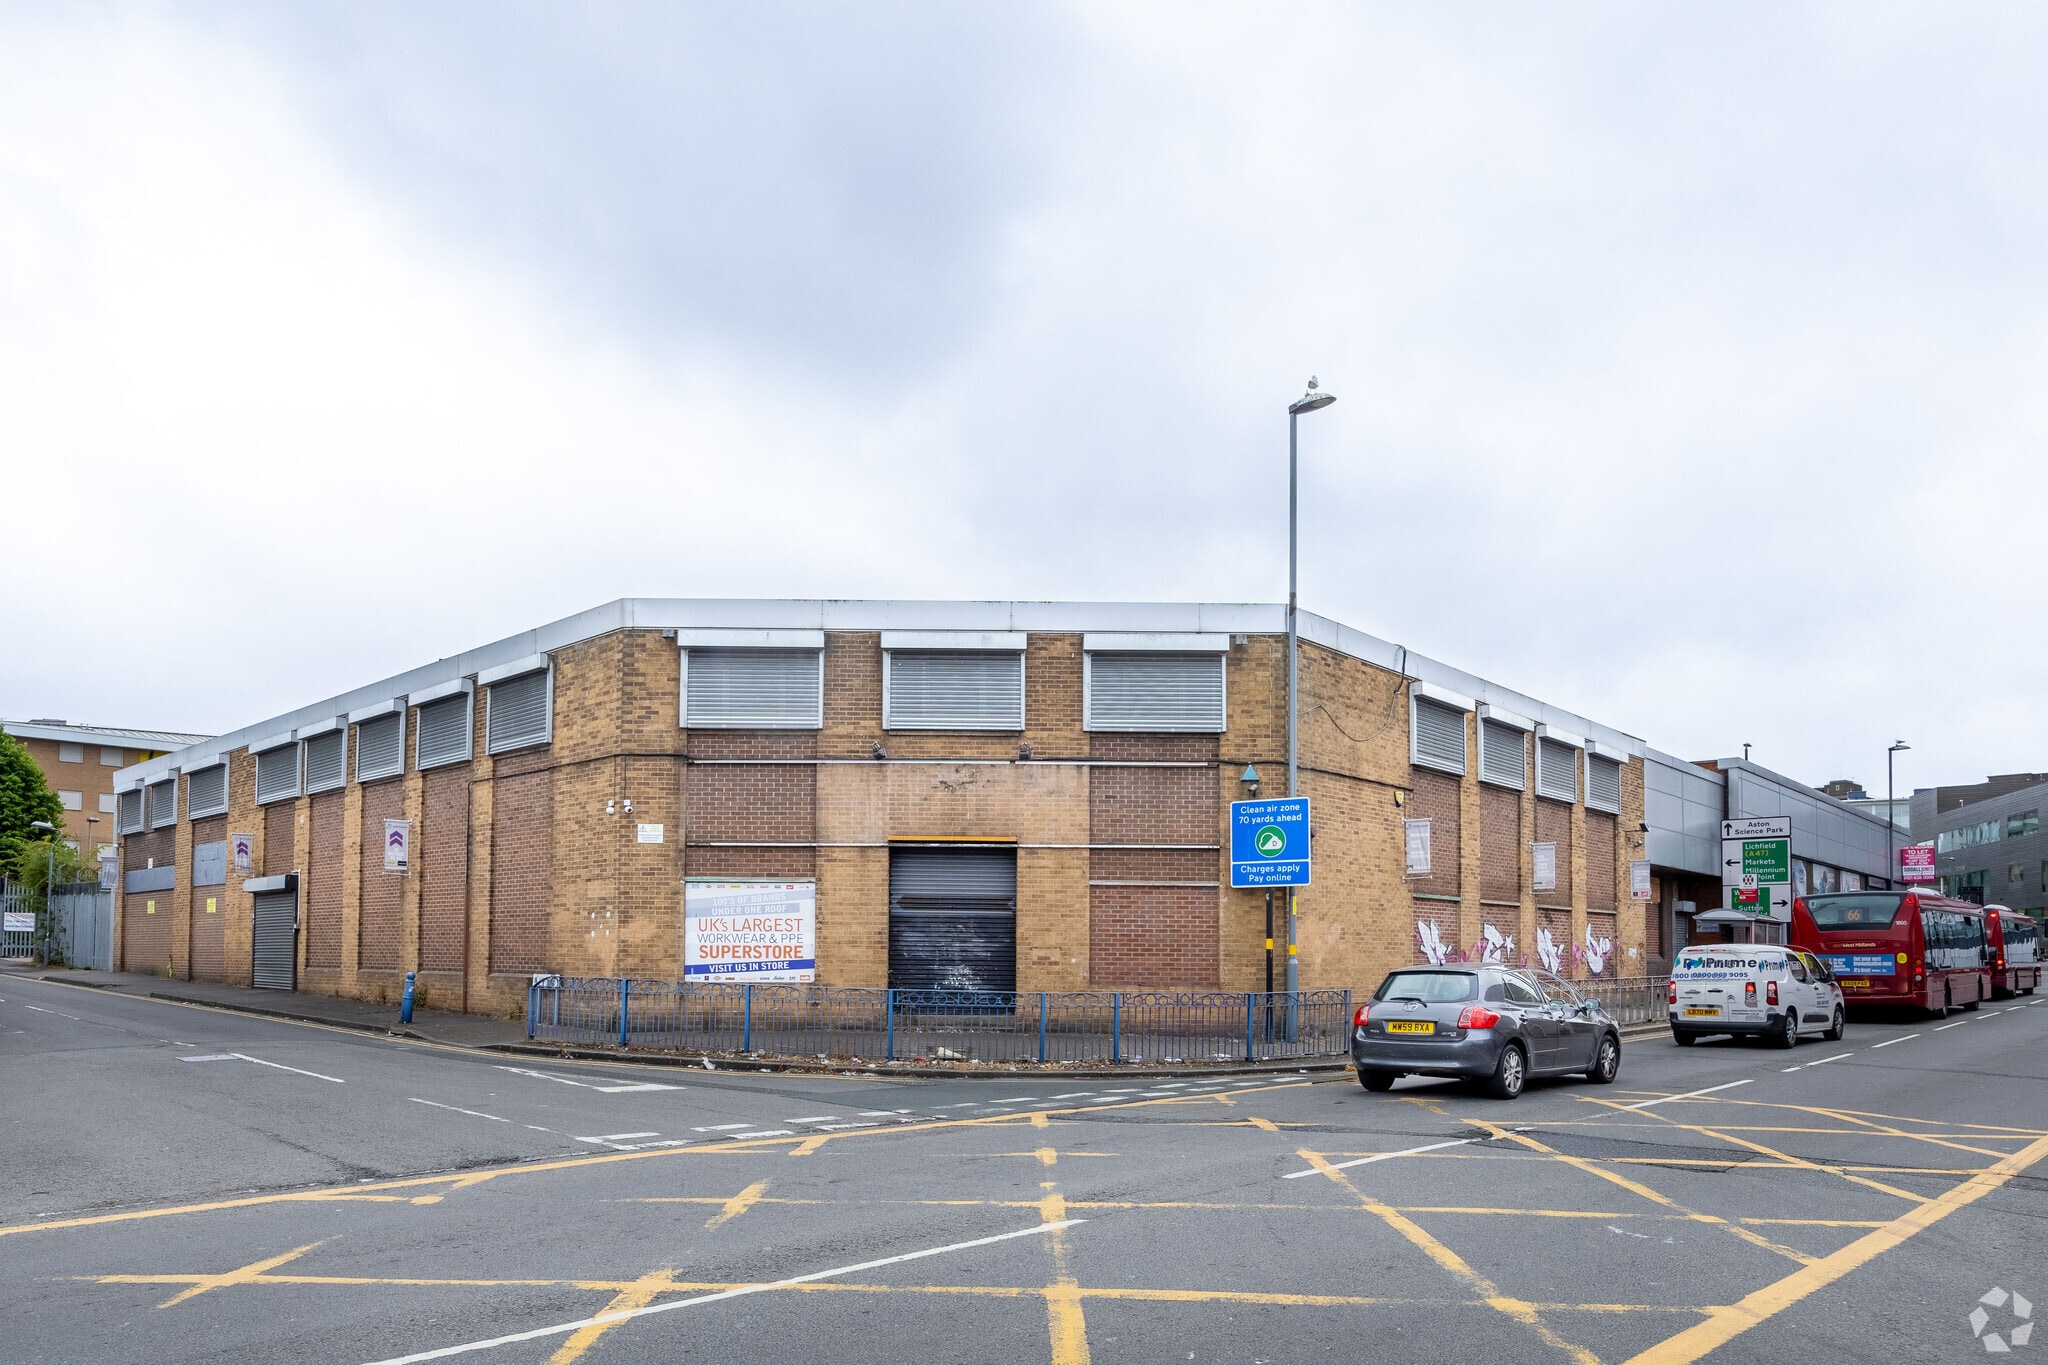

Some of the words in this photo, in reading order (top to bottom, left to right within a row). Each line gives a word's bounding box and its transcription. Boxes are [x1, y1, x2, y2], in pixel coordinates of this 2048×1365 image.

[1240, 806, 1264, 814] Clean
[1252, 815, 1274, 824] yards
[1276, 814, 1302, 822] ahead
[1240, 865, 1274, 874] Charges
[1277, 864, 1300, 873] apply
[1249, 875, 1264, 883] Pay
[712, 896, 736, 906] 100'S
[738, 895, 749, 904] OF
[751, 892, 786, 903] BRANDS
[712, 906, 742, 916] UNDER
[744, 906, 762, 914] ONE
[765, 904, 788, 913] ROOF
[1848, 909, 1860, 920] 66
[698, 918, 728, 932] UK's
[732, 918, 804, 932] LARGEST
[697, 933, 766, 944] WORKWEAR
[768, 933, 778, 944] &
[781, 933, 804, 943] PPE
[699, 944, 804, 959] SUPERSTORE
[709, 964, 733, 973] VISIT
[735, 963, 747, 972] US
[761, 962, 789, 970] STORE
